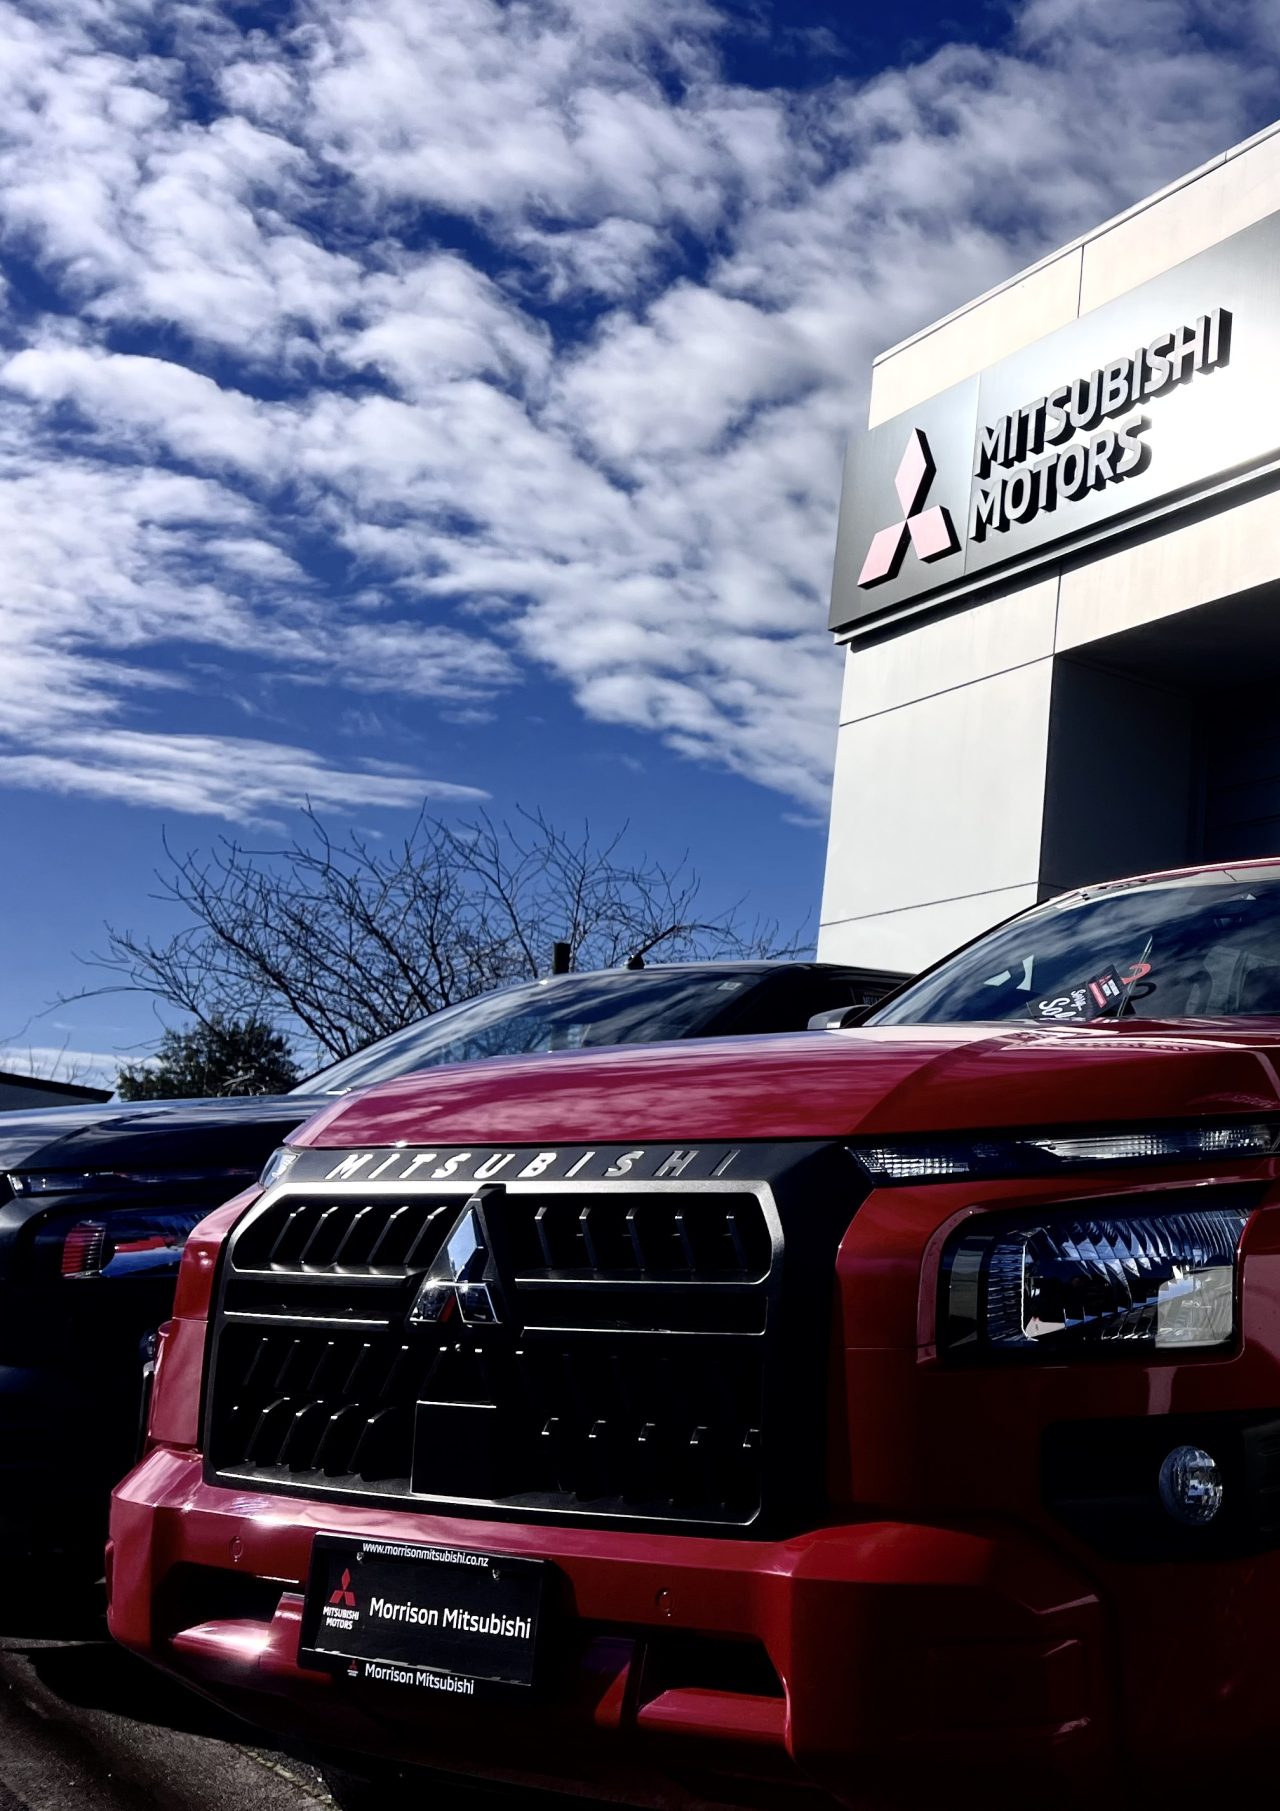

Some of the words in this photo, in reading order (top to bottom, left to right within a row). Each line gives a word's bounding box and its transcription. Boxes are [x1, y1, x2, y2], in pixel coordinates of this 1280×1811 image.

[974, 308, 1233, 480] MITSUBISHI
[969, 414, 1152, 543] MOTORS
[324, 1149, 741, 1181] MITSUBISHI
[362, 1542, 489, 1568] www.morrisonmitsubishi.co.nz
[323, 1606, 360, 1621] MITSUBISHI
[326, 1616, 354, 1630] MOTORS
[369, 1597, 438, 1626] Morrison
[442, 1608, 532, 1639] Mitsubishi
[365, 1663, 414, 1684] Morrison
[416, 1672, 475, 1695] Mitsubishi
